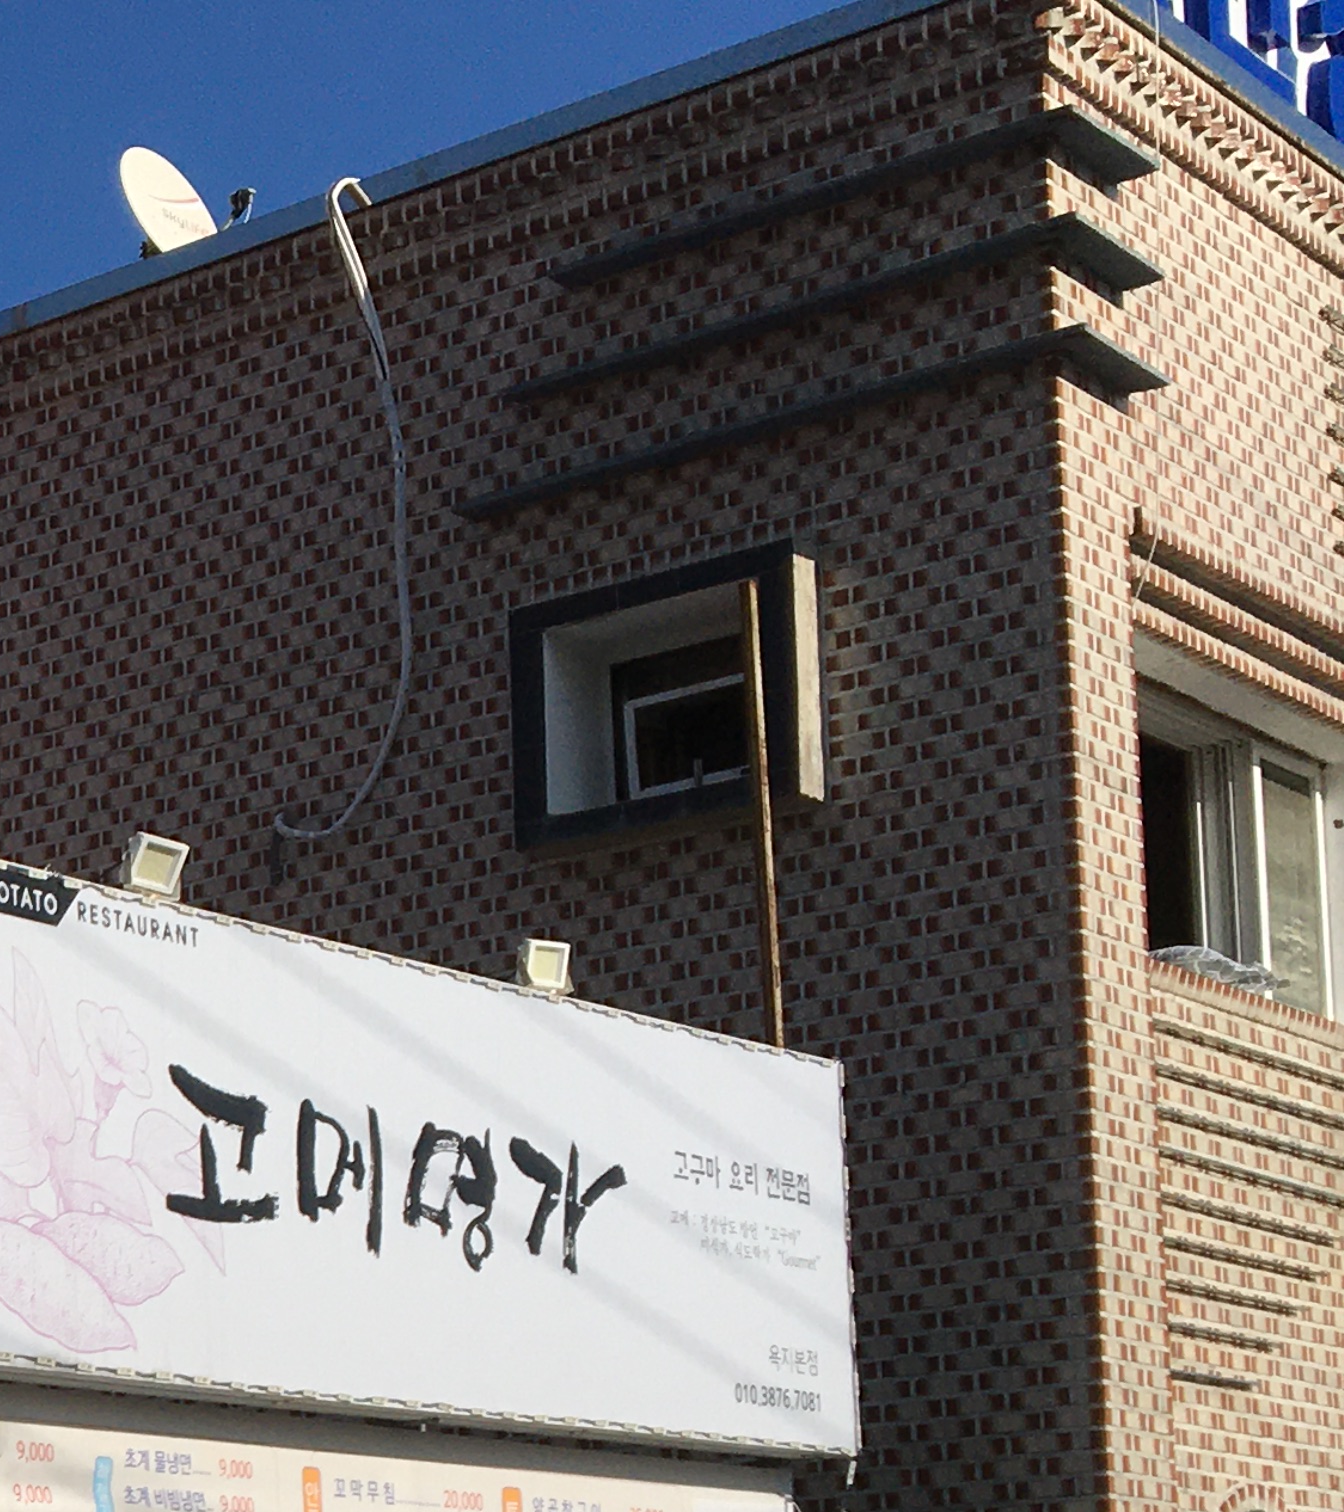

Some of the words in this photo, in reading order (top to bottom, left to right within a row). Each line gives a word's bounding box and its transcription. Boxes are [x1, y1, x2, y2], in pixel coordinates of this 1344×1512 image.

[77, 900, 199, 947] RESTAURANT
[165, 1063, 627, 1273] 고메명가
[674, 1150, 721, 1189] 고구마
[729, 1161, 759, 1195] 요리
[766, 1167, 811, 1206] 전문점
[768, 1344, 819, 1377] 욕지본점
[734, 1382, 822, 1412] 010.3876.7081
[15, 1439, 55, 1463] 9,000
[123, 1448, 151, 1472] 초계
[153, 1450, 193, 1476] 물냉면
[218, 1458, 254, 1480] 9,000
[13, 1483, 54, 1504] 9,000
[123, 1485, 152, 1508] 초계
[443, 1489, 484, 1512] 20,000
